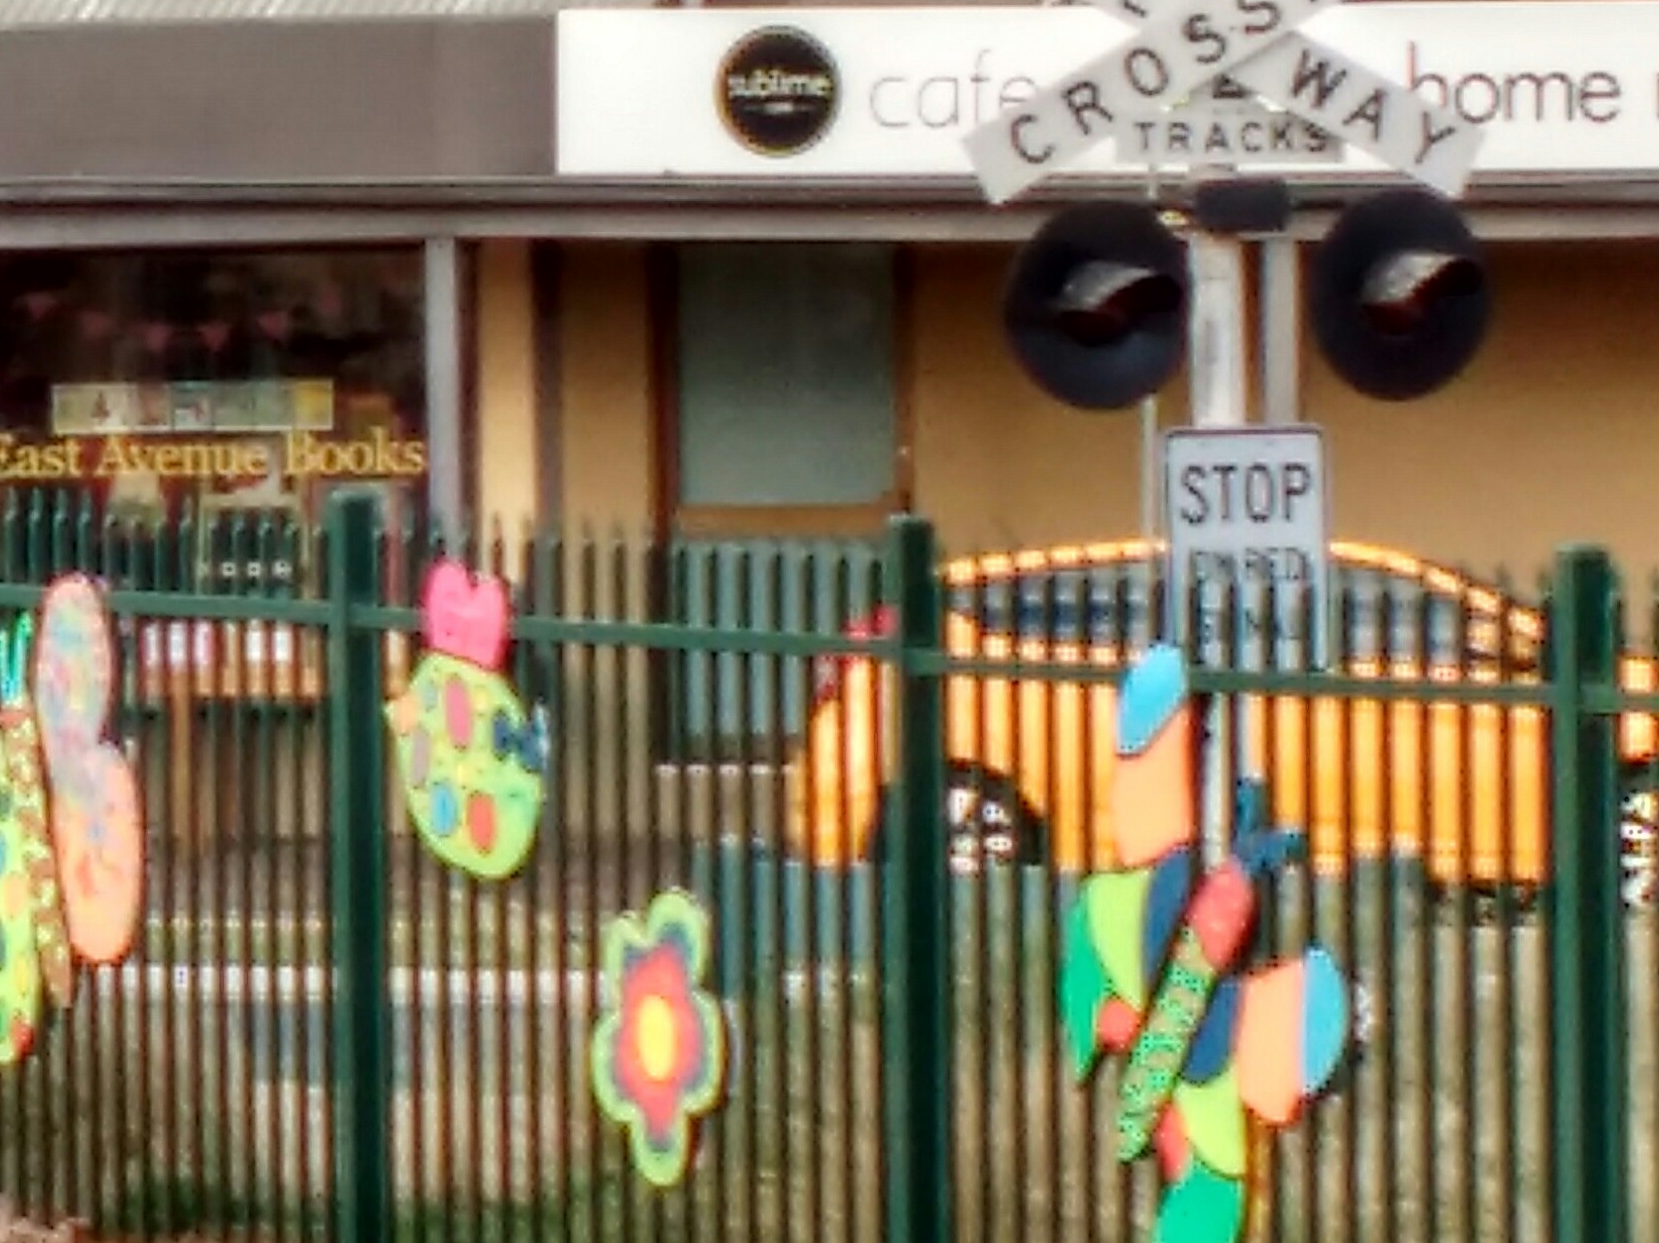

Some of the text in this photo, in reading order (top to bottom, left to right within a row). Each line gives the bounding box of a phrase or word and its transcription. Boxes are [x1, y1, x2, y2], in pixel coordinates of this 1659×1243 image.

[870, 50, 1042, 130] cafe
[1405, 40, 1622, 126] home
[1288, 46, 1458, 166] WAY
[1134, 120, 1330, 153] TRACKS
[95, 435, 268, 476] Avenue
[281, 428, 427, 475] Books
[1180, 462, 1311, 524] STOP
